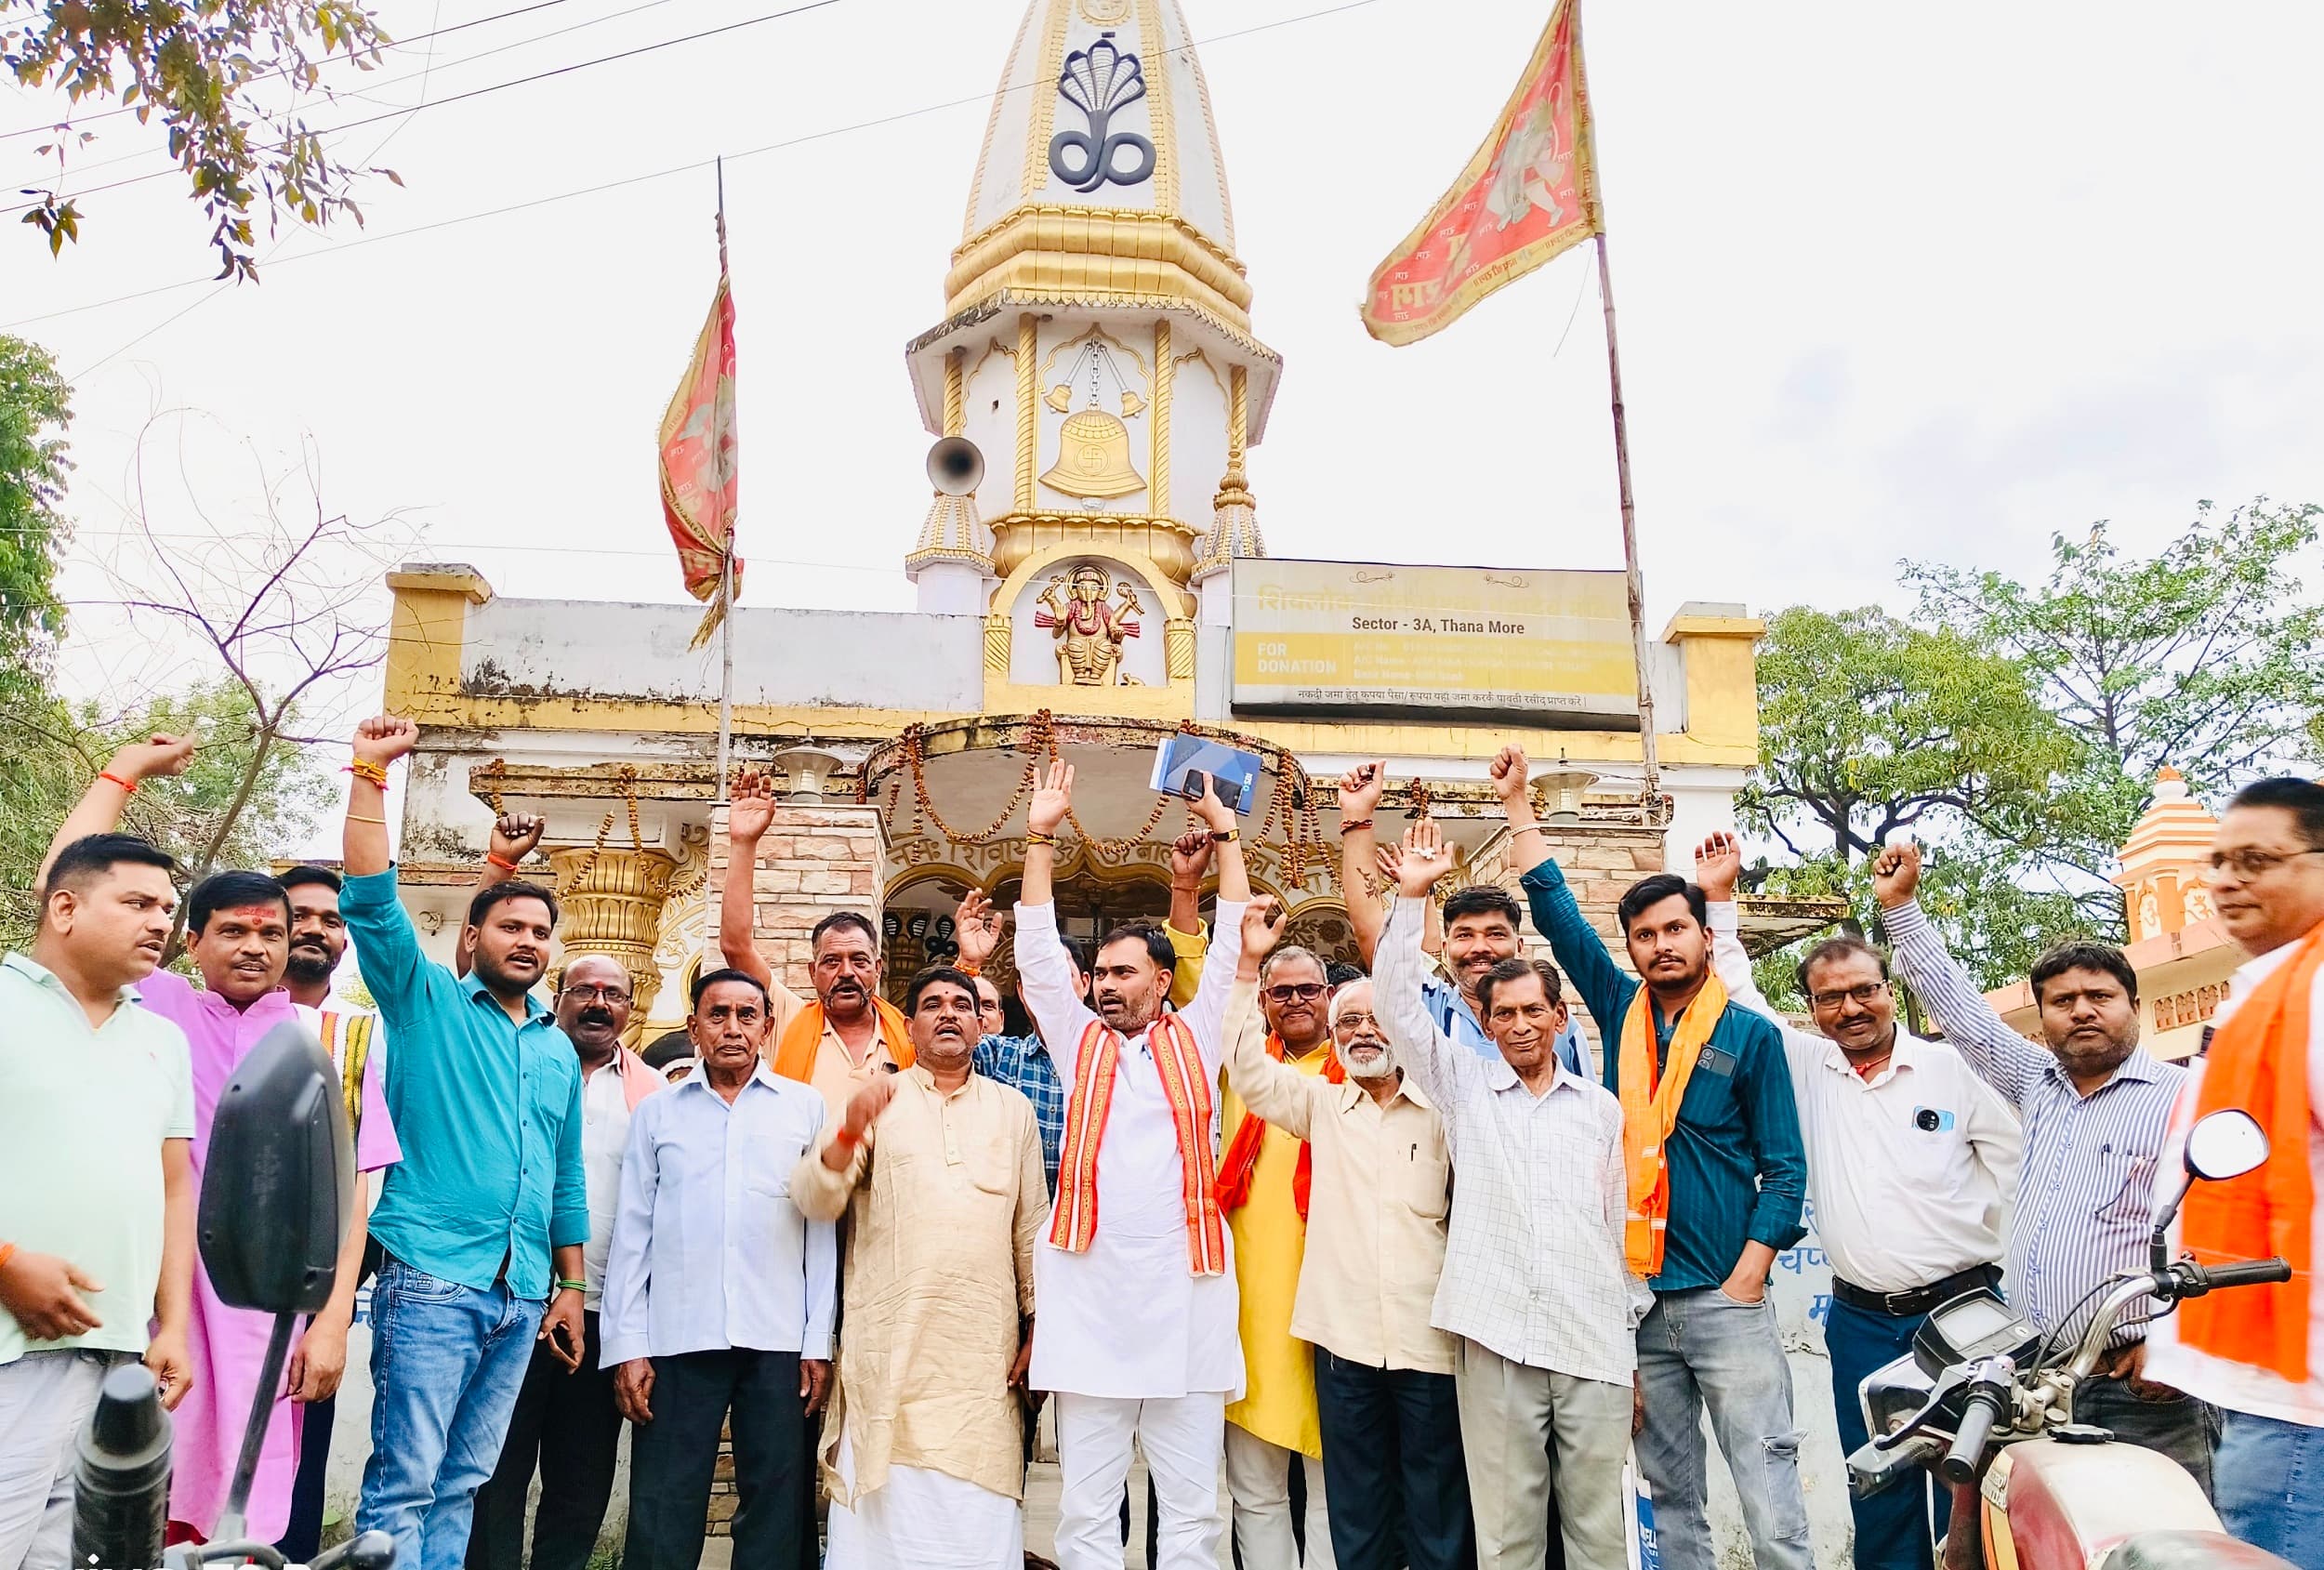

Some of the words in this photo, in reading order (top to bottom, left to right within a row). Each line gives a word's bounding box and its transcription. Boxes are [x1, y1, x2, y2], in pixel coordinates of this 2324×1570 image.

[1353, 616, 1398, 630] Sector
[1413, 618, 1436, 634] 3A,
[1441, 619, 1484, 634] Thana
[1488, 620, 1525, 635] More
[1258, 642, 1287, 656] FOR
[1258, 659, 1337, 675] DONATION
